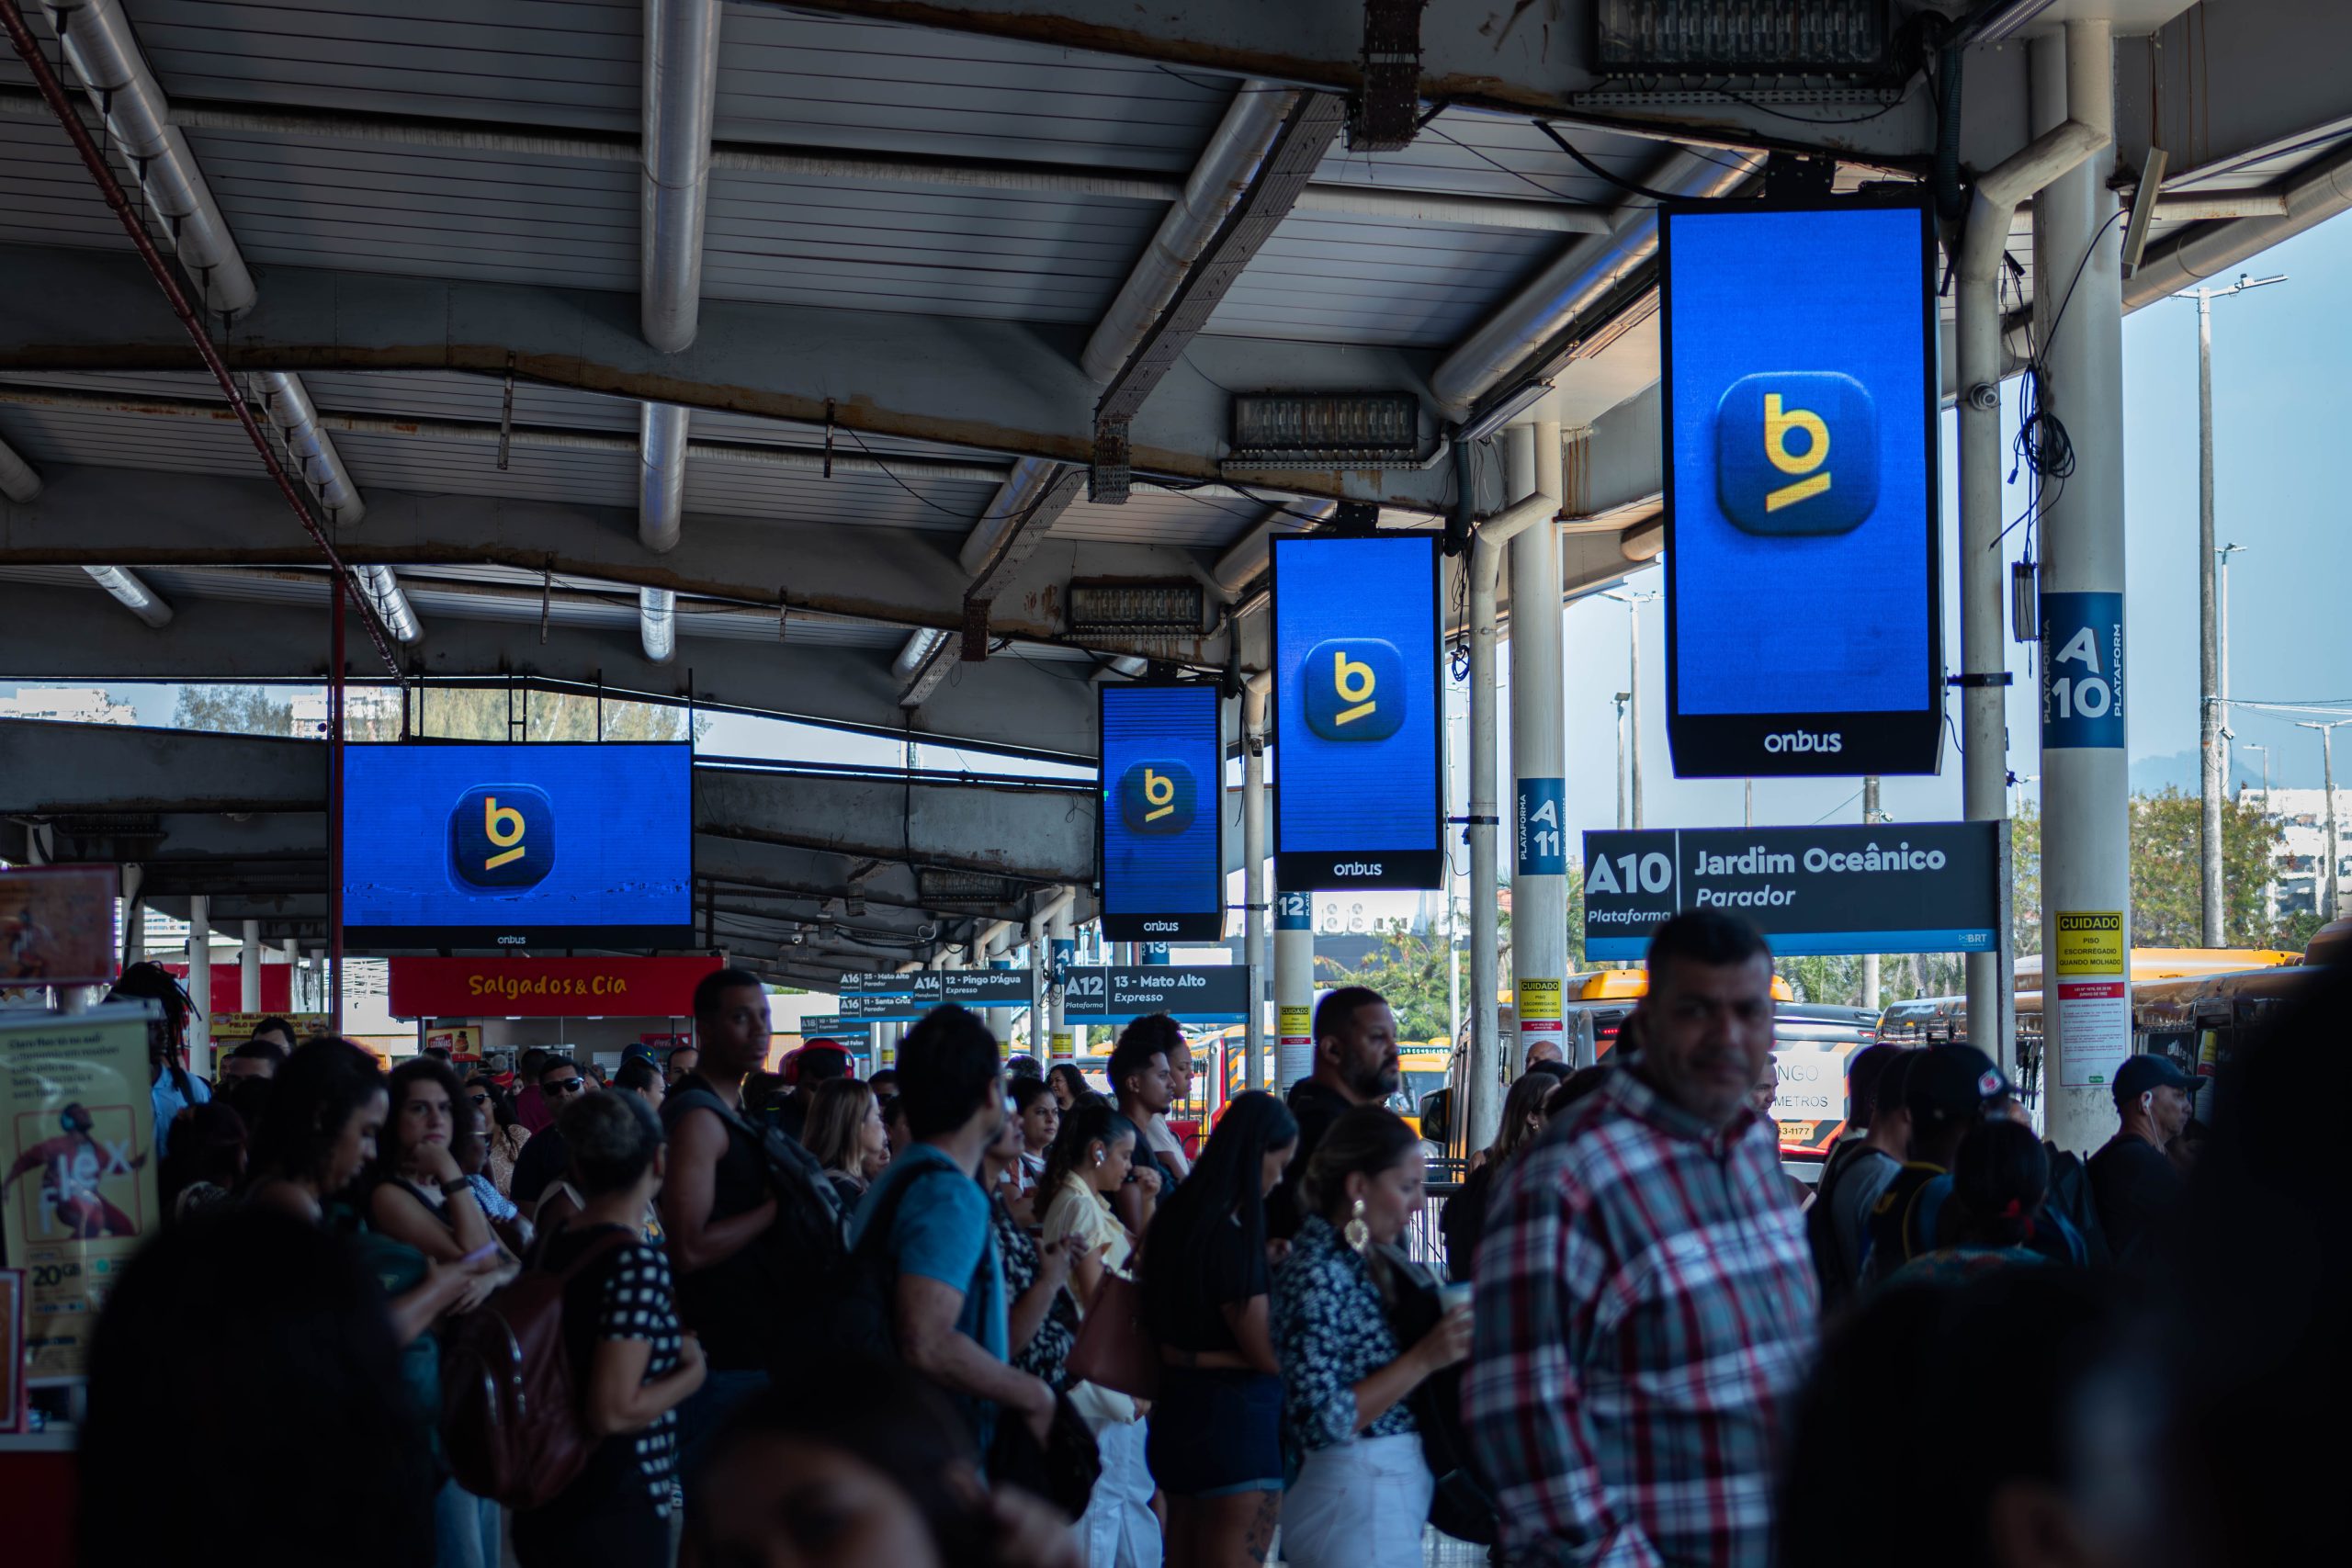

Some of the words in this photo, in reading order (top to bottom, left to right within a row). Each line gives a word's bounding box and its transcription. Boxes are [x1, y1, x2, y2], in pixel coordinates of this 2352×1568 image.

[2055, 626, 2099, 673] A
[2052, 677, 2110, 718] 10
[1764, 729, 1842, 752] onbus
[1530, 799, 1557, 829] A
[1533, 830, 1559, 856] 11
[1695, 846, 1795, 875] Jardim
[1804, 842, 1946, 873] Oceânico
[1333, 862, 1383, 875] onbus
[1585, 852, 1672, 894] A10
[1696, 885, 1796, 908] Parador
[1278, 897, 1304, 916] 12
[1588, 908, 1670, 924] Plataforma
[2061, 918, 2119, 930] CUIDADO
[1143, 920, 1179, 931] onbus
[497, 935, 526, 944] onbus
[1968, 933, 1987, 942] BRT
[469, 974, 572, 1000] Salgados
[575, 979, 588, 996] &
[592, 975, 628, 996] Cia
[841, 974, 860, 984] A16
[914, 976, 940, 989] A14
[945, 976, 956, 985] 12
[963, 976, 989, 986] Pingo
[990, 973, 1021, 984] D'Água
[1065, 976, 1104, 996] A12
[1114, 976, 1129, 987] 13
[1140, 975, 1175, 987] Mato
[1178, 974, 1206, 987] Alto
[841, 998, 860, 1009] A16
[1066, 1001, 1103, 1010] Plataforma
[1114, 992, 1163, 1004] Expresso
[1778, 1065, 1819, 1081] NGO
